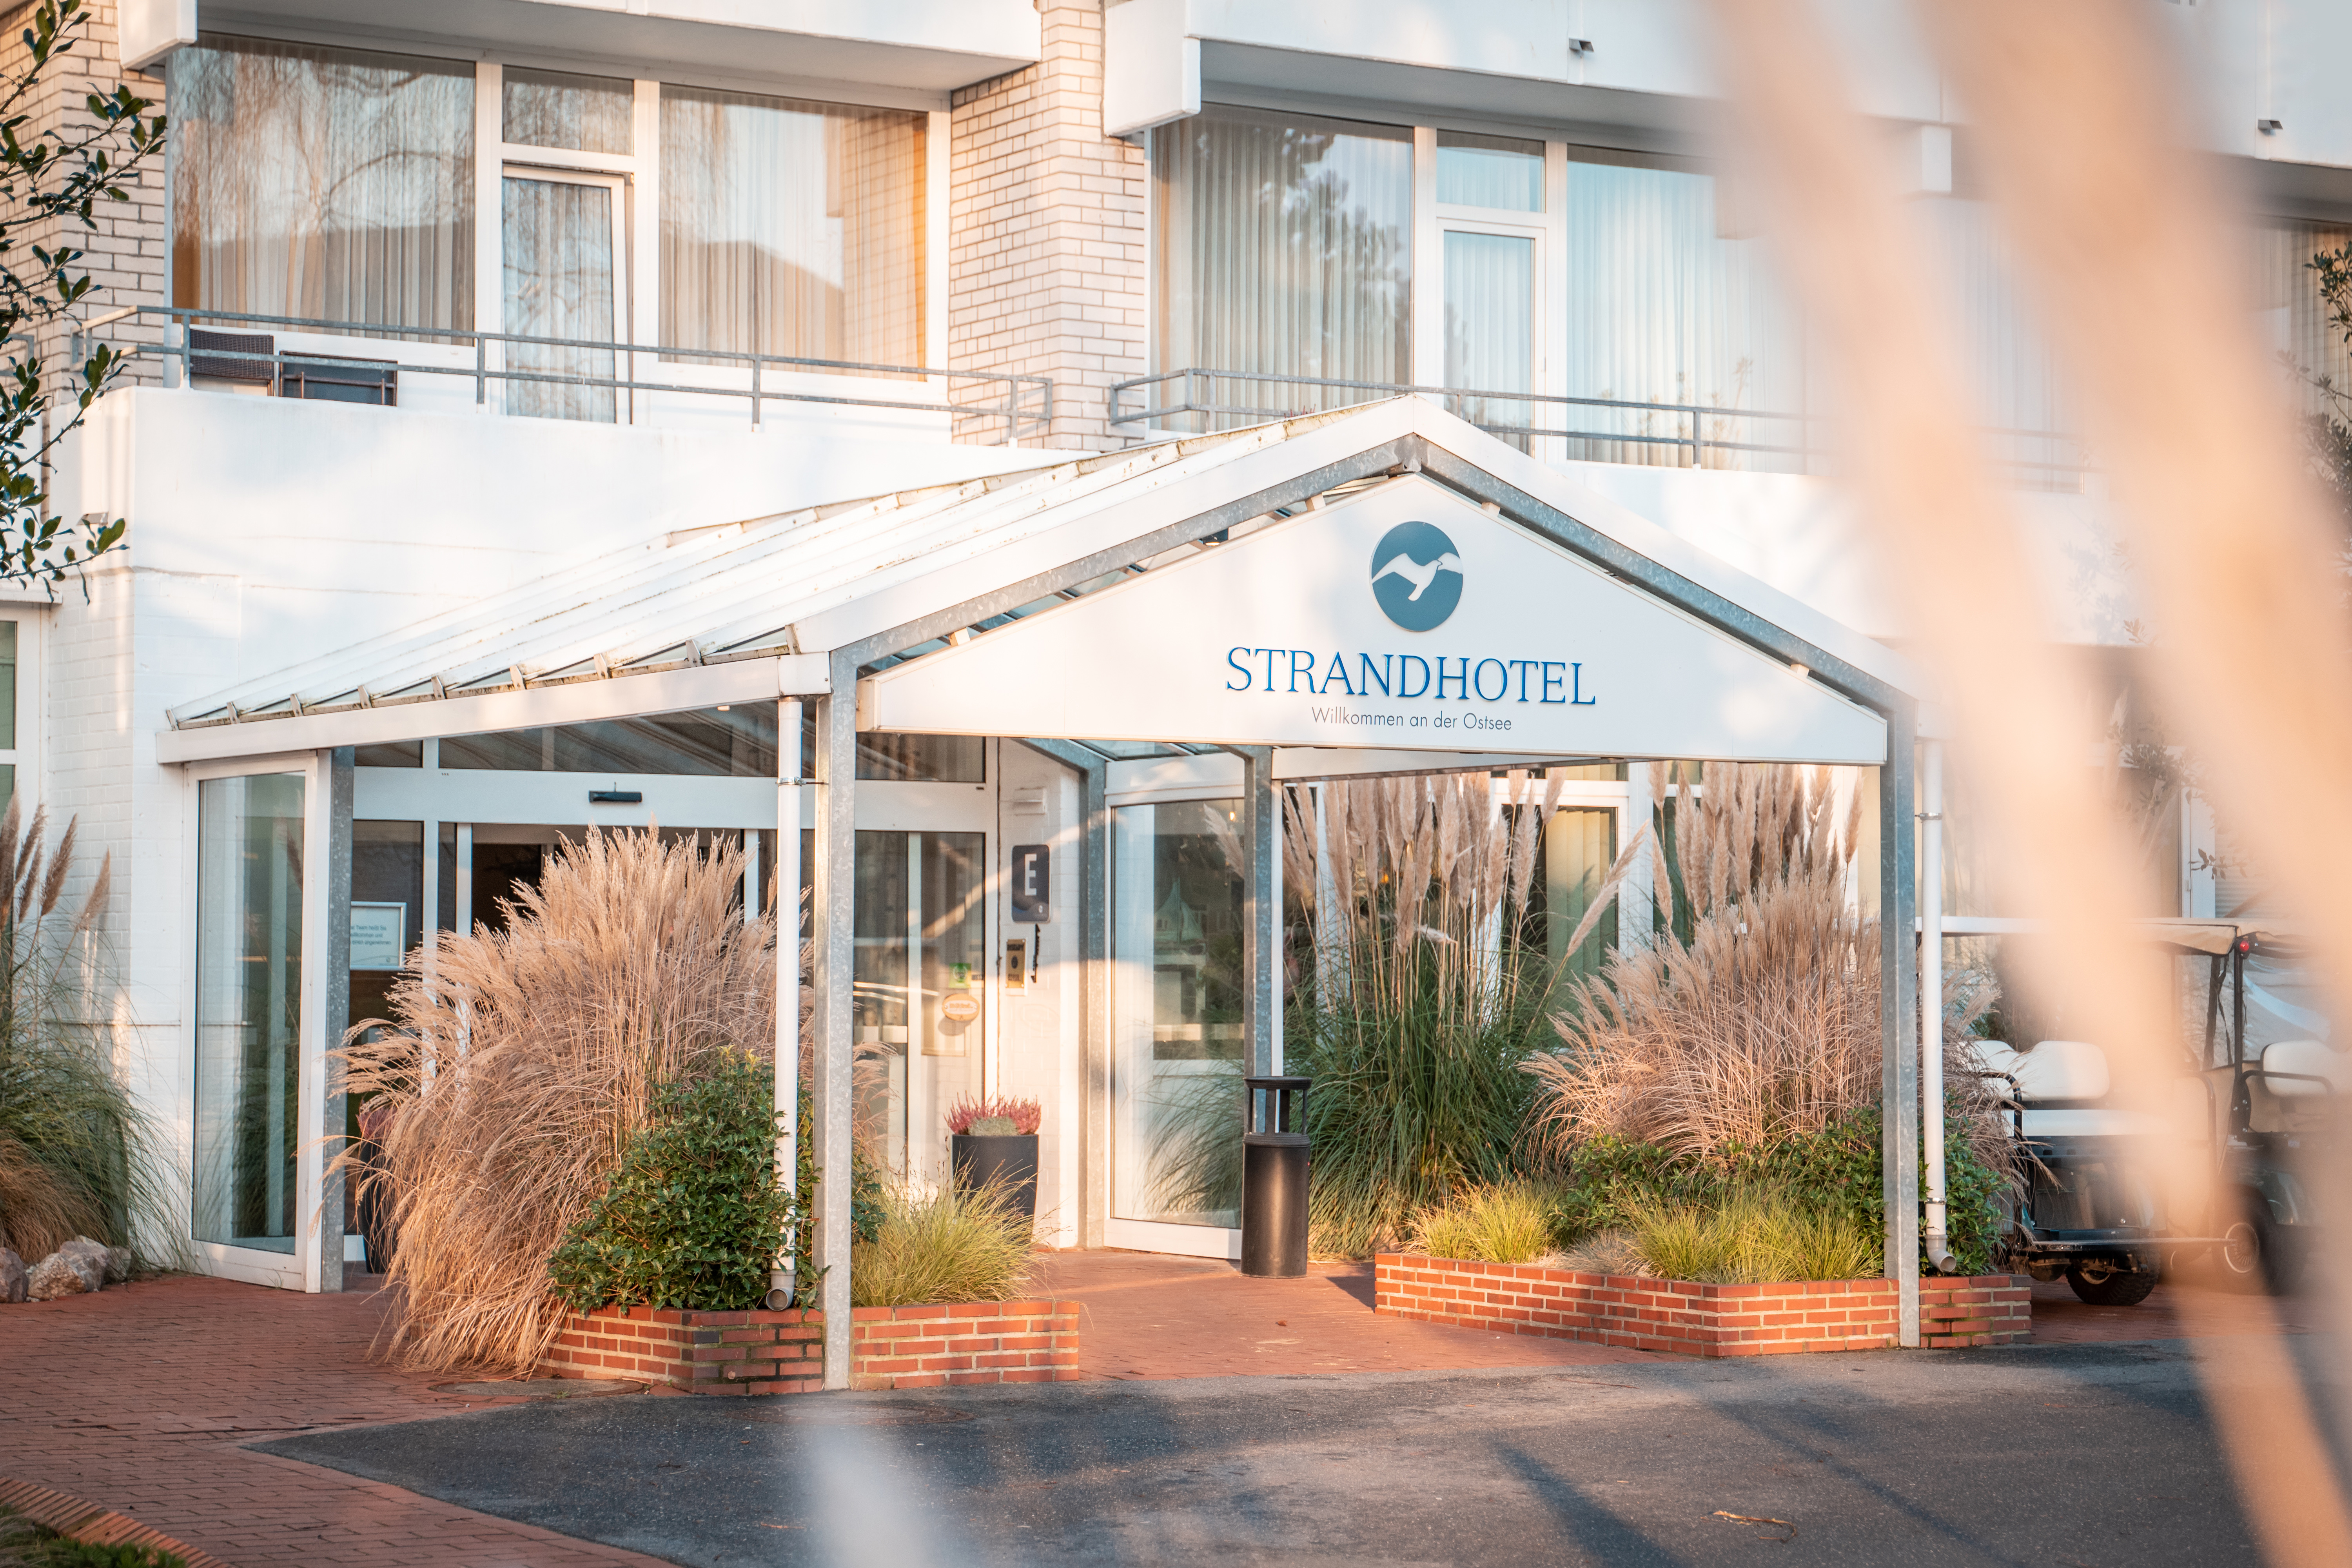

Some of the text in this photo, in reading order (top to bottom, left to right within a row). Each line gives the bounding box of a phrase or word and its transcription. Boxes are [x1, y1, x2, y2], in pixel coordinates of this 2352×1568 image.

[1226, 647, 1596, 705] STRANDHOTEL
[1312, 706, 1512, 730] Willkommen an der Ostsee
[1025, 853, 1037, 896] E
